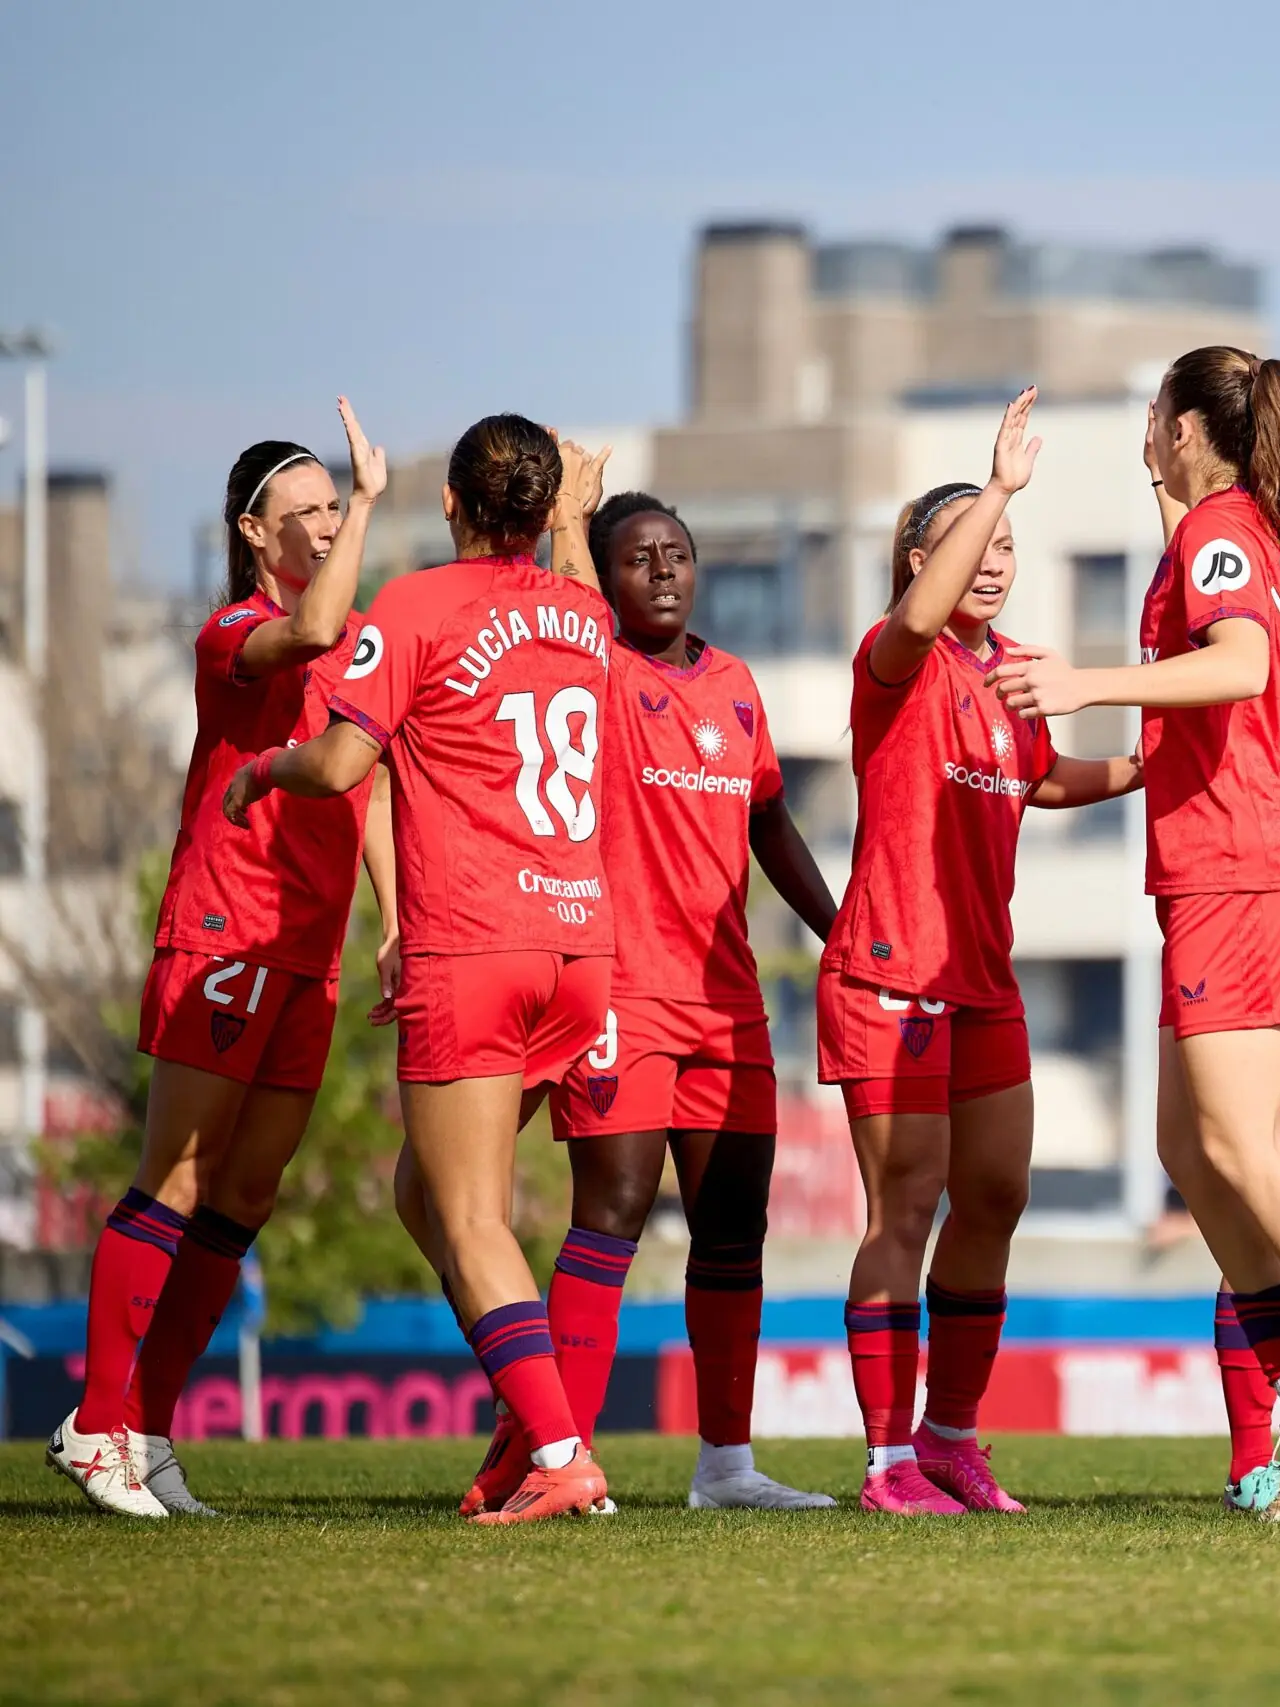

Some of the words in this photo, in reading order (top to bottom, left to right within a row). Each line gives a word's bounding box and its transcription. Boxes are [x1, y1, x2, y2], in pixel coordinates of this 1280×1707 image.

[1202, 551, 1243, 587] JD
[444, 607, 532, 698] LUCÍA
[536, 605, 610, 682] MORA
[493, 685, 599, 843] 18
[557, 901, 587, 925] 0.0
[203, 955, 268, 1014] 21
